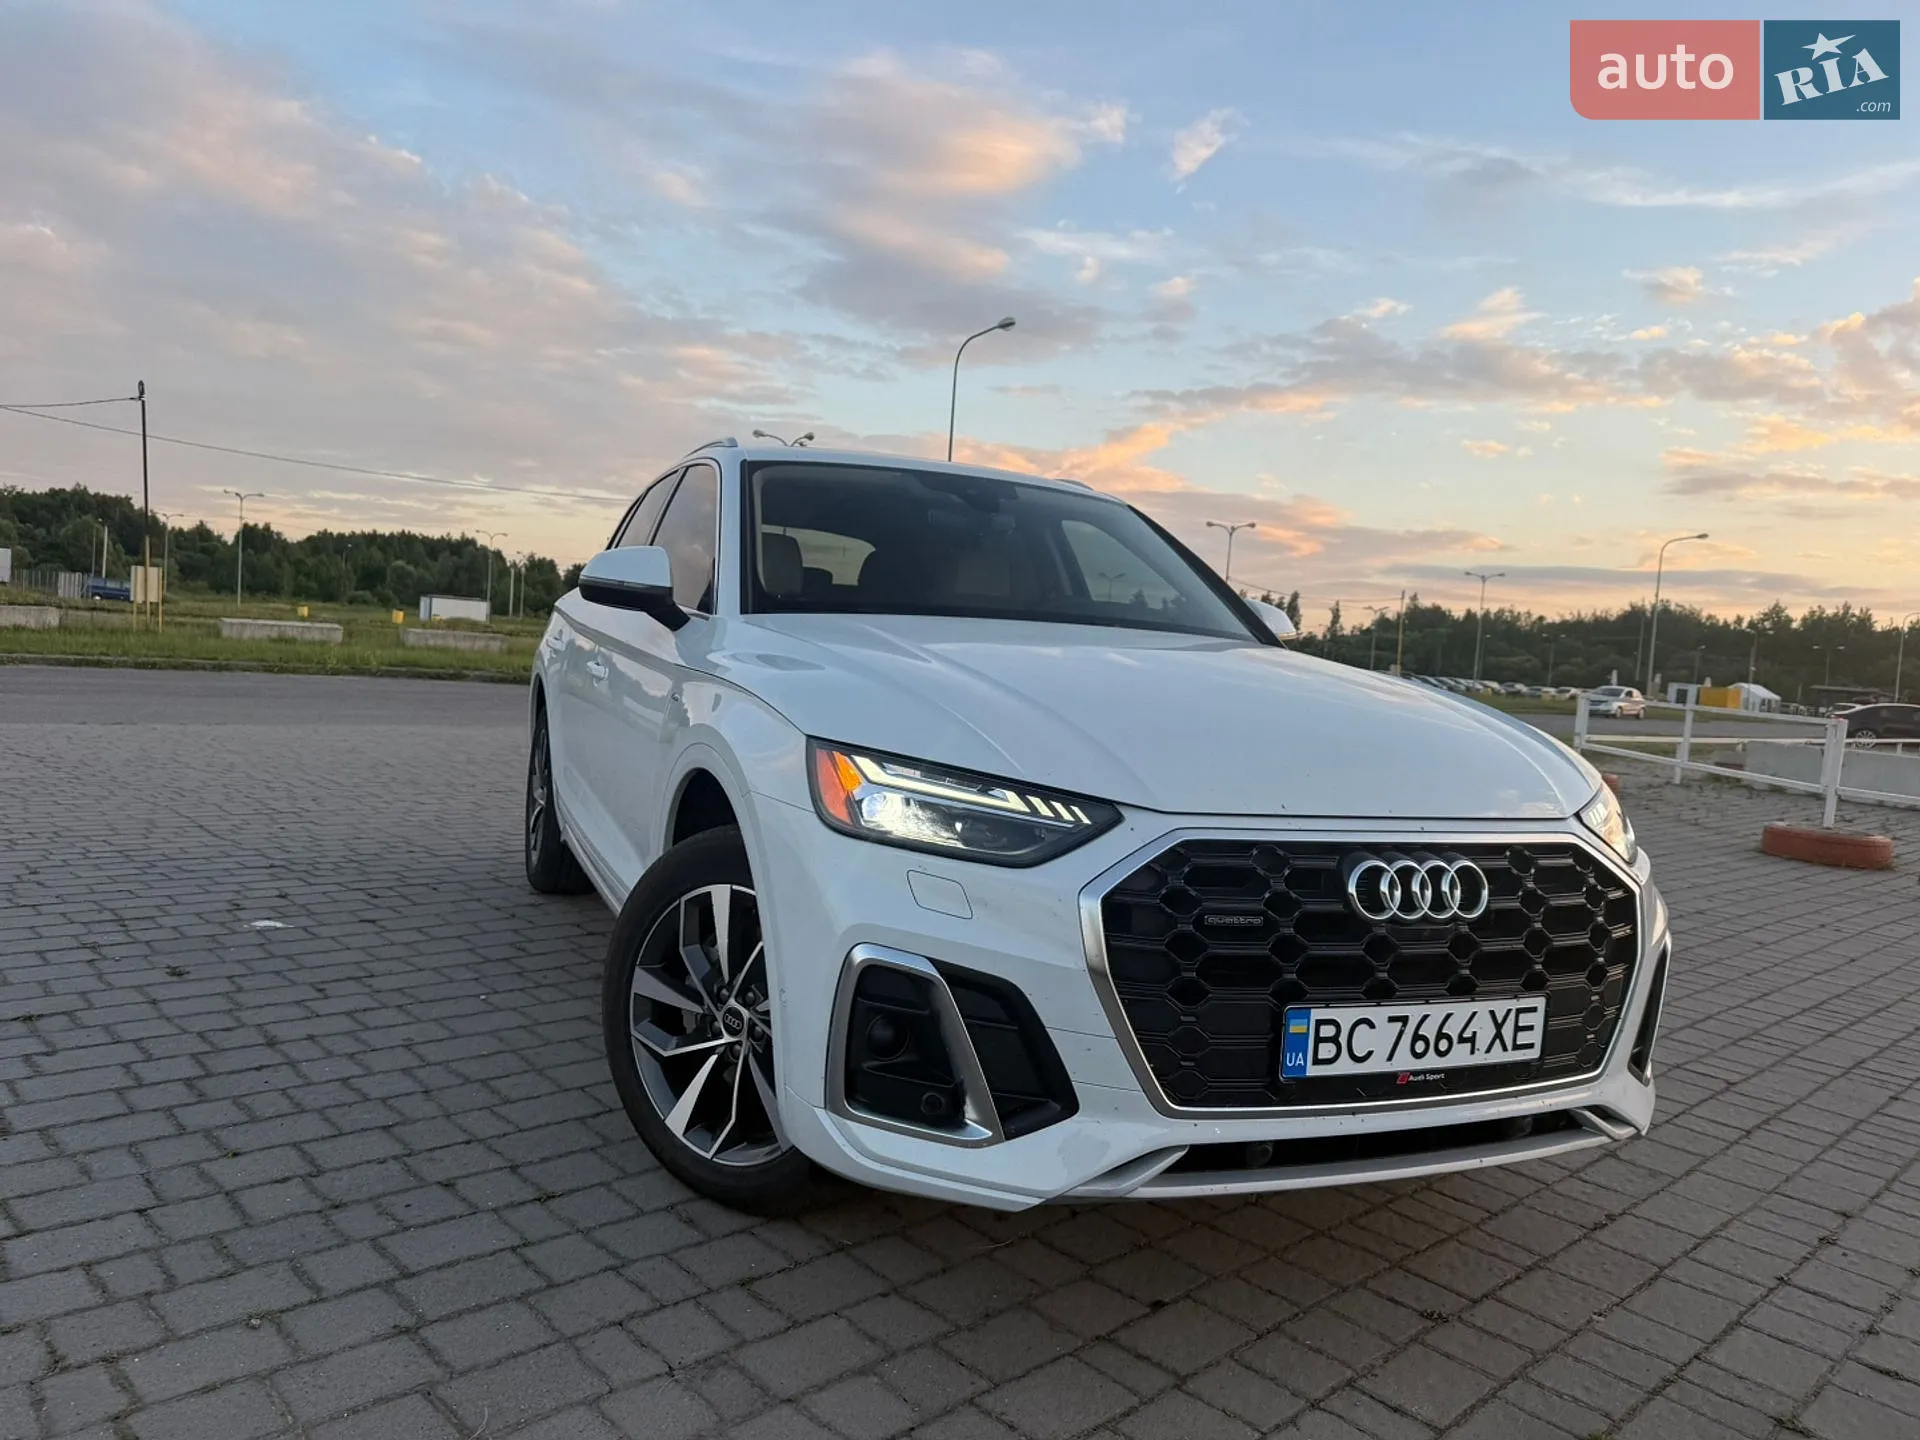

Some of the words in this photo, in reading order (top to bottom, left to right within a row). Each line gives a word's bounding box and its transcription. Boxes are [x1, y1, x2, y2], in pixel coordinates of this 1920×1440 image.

[1312, 1017, 1376, 1067] BC
[1386, 1010, 1479, 1062] 7664
[1484, 1006, 1538, 1054] XE
[1286, 1053, 1305, 1067] UA
[1408, 1074, 1425, 1082] Audi
[1426, 1073, 1446, 1081] Sport
